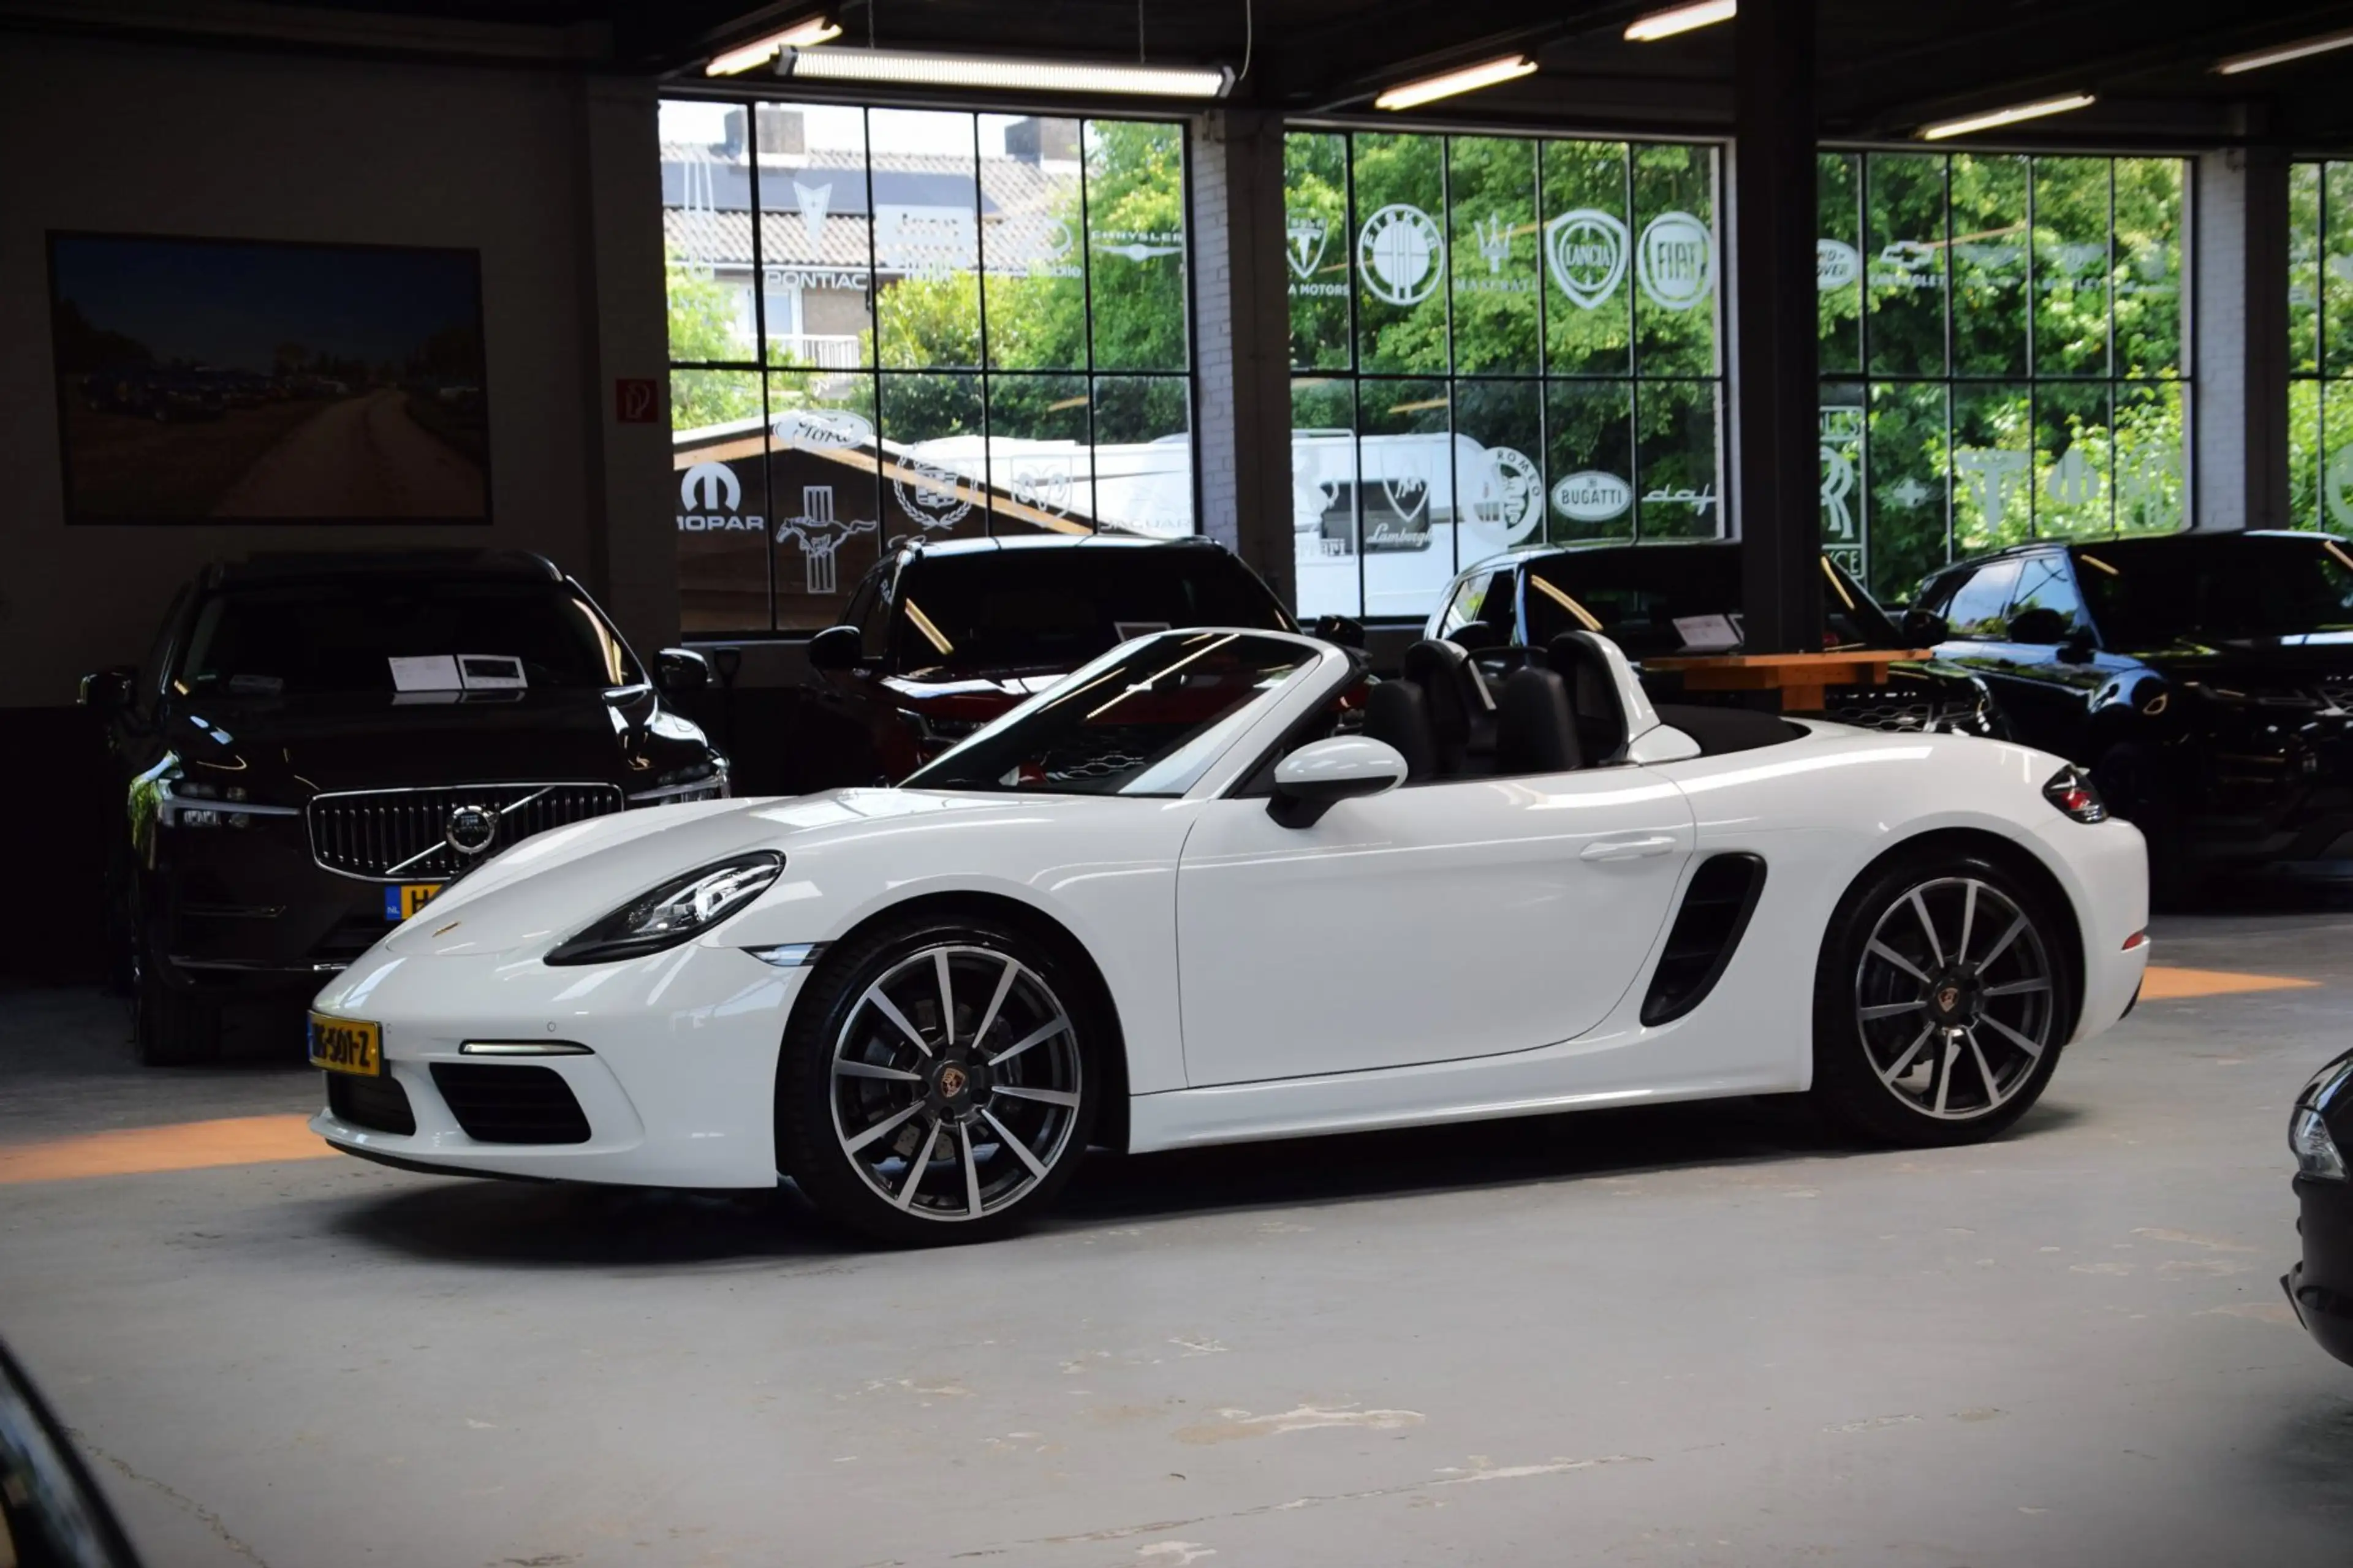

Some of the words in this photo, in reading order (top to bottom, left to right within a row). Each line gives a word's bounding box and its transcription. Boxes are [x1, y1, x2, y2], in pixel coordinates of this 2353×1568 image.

[1566, 243, 1611, 266] LANCIA
[1658, 241, 1699, 280] FIAT
[765, 270, 869, 291] PONTIAC
[1496, 450, 1541, 497] ROMEO
[1561, 490, 1622, 505] BUGATTI
[387, 905, 400, 914] NL
